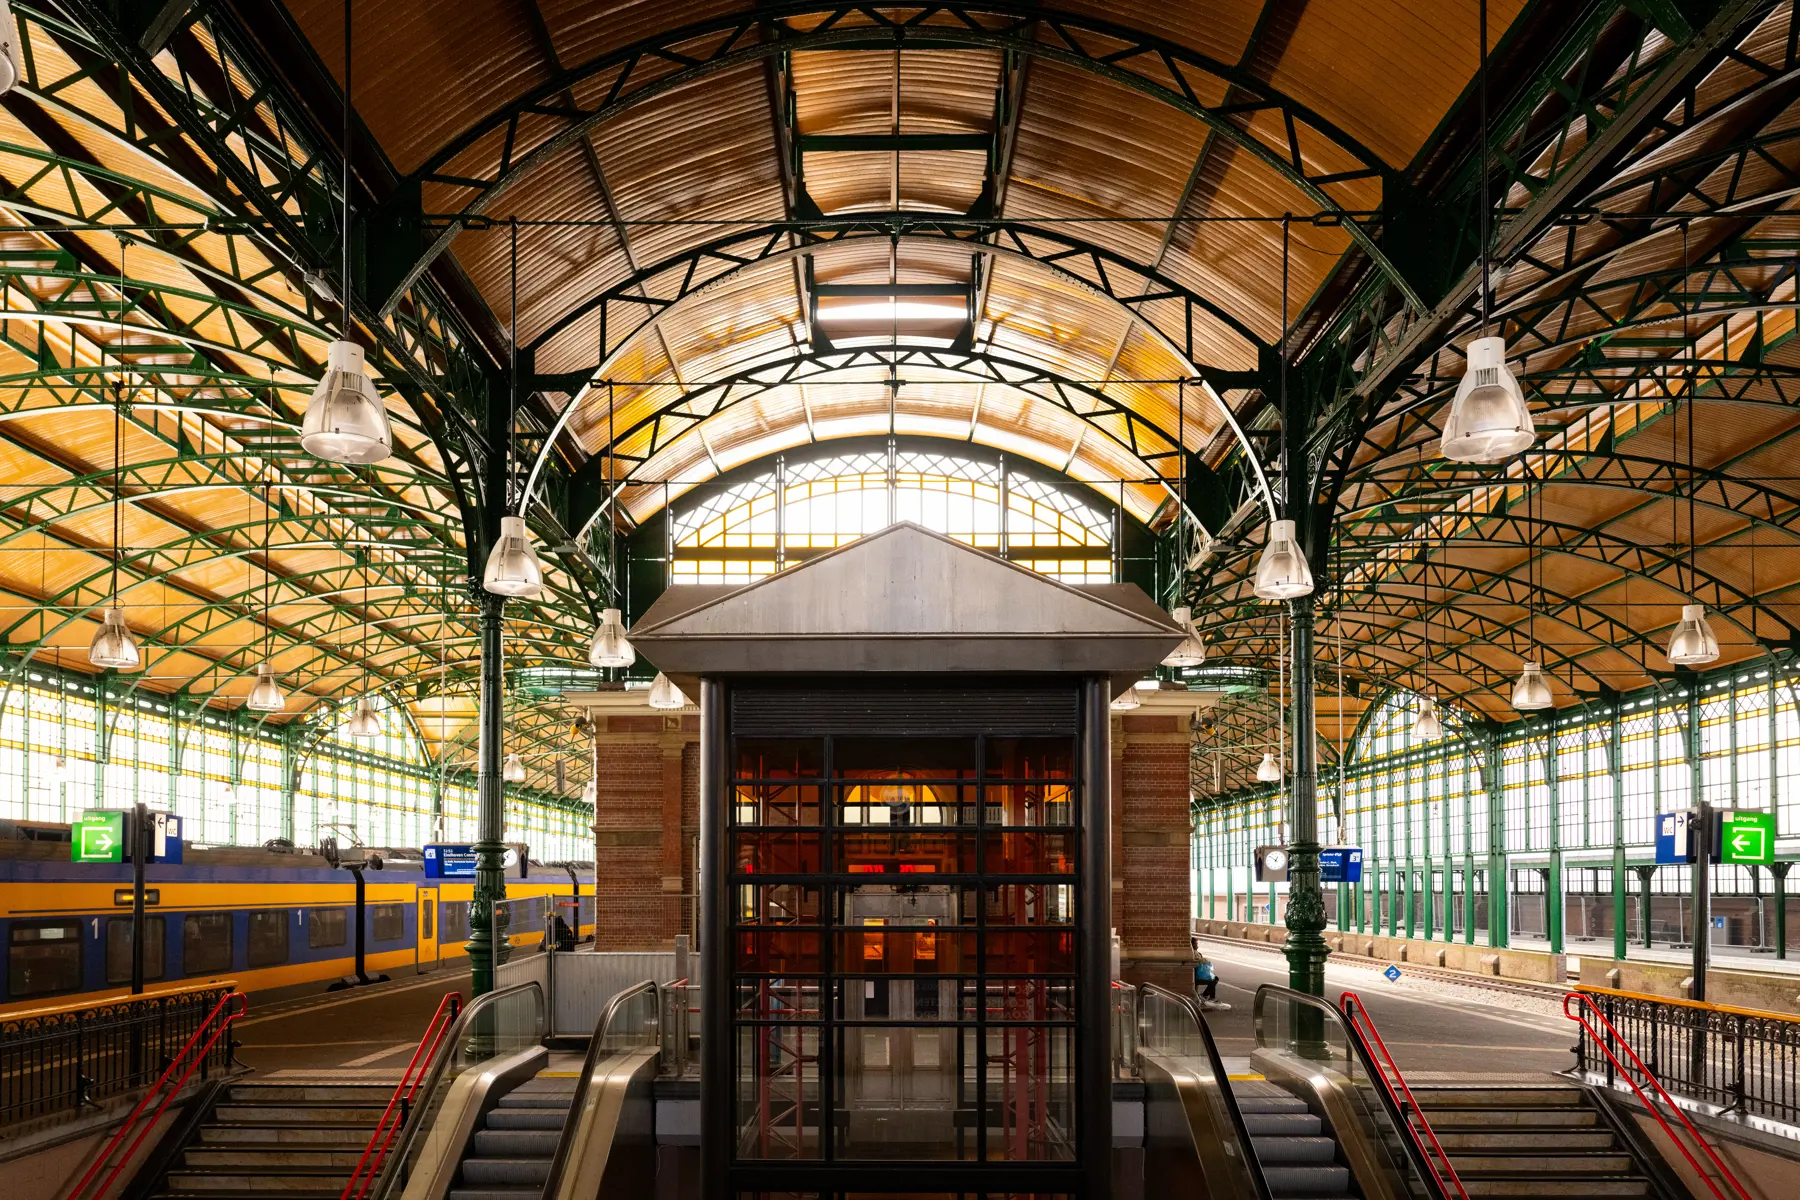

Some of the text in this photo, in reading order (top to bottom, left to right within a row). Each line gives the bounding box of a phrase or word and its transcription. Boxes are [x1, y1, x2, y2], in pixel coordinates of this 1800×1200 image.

[83, 815, 106, 823] uitgang
[168, 828, 177, 836] WC
[1663, 826, 1673, 834] WC
[297, 909, 302, 926] 1
[91, 918, 99, 939] 1
[1389, 970, 1397, 978] 2
